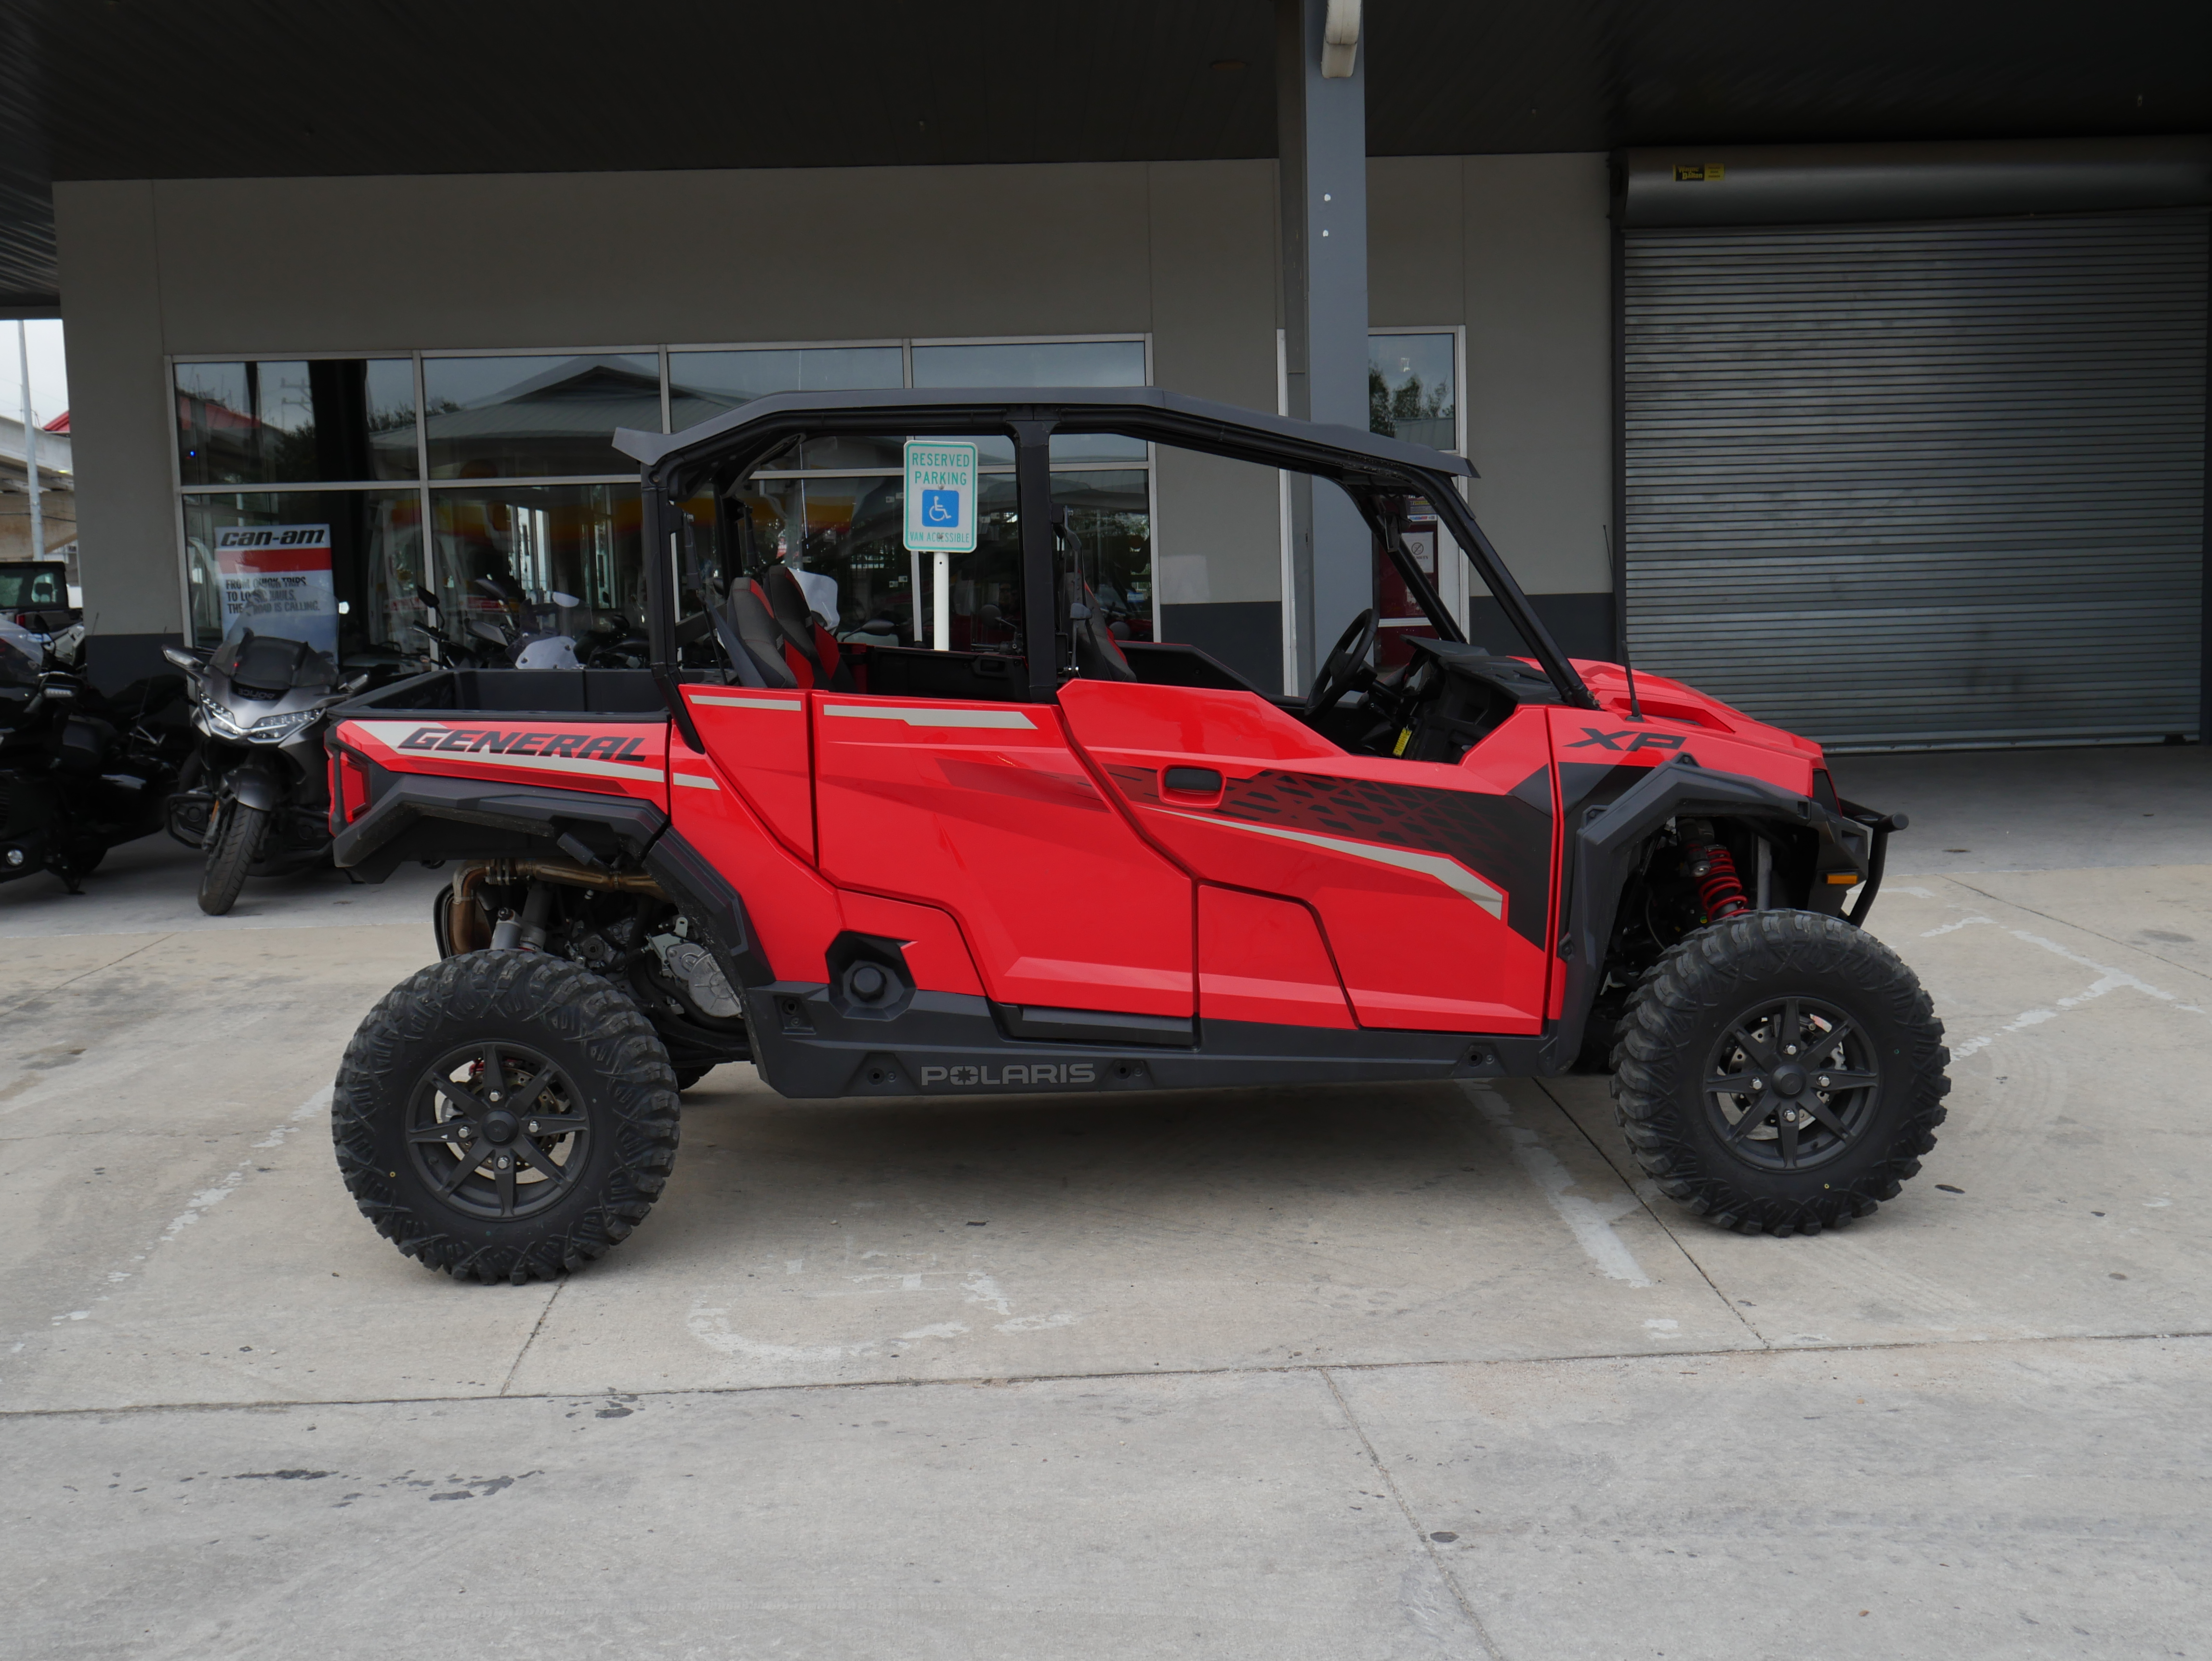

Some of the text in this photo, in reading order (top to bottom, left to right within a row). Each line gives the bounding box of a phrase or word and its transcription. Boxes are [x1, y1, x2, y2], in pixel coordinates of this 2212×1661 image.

[912, 453, 969, 467] RESERVED
[915, 471, 967, 485] PARKING
[221, 529, 324, 546] can-am
[910, 532, 969, 543] VAN ACCESSIBLE
[226, 579, 250, 589] FROM
[227, 591, 237, 601] TO
[227, 603, 243, 614] THE
[274, 602, 281, 612] IS
[397, 727, 645, 762] GENERAL
[1563, 727, 1687, 751] XP
[921, 1063, 1096, 1086] POLARIS
